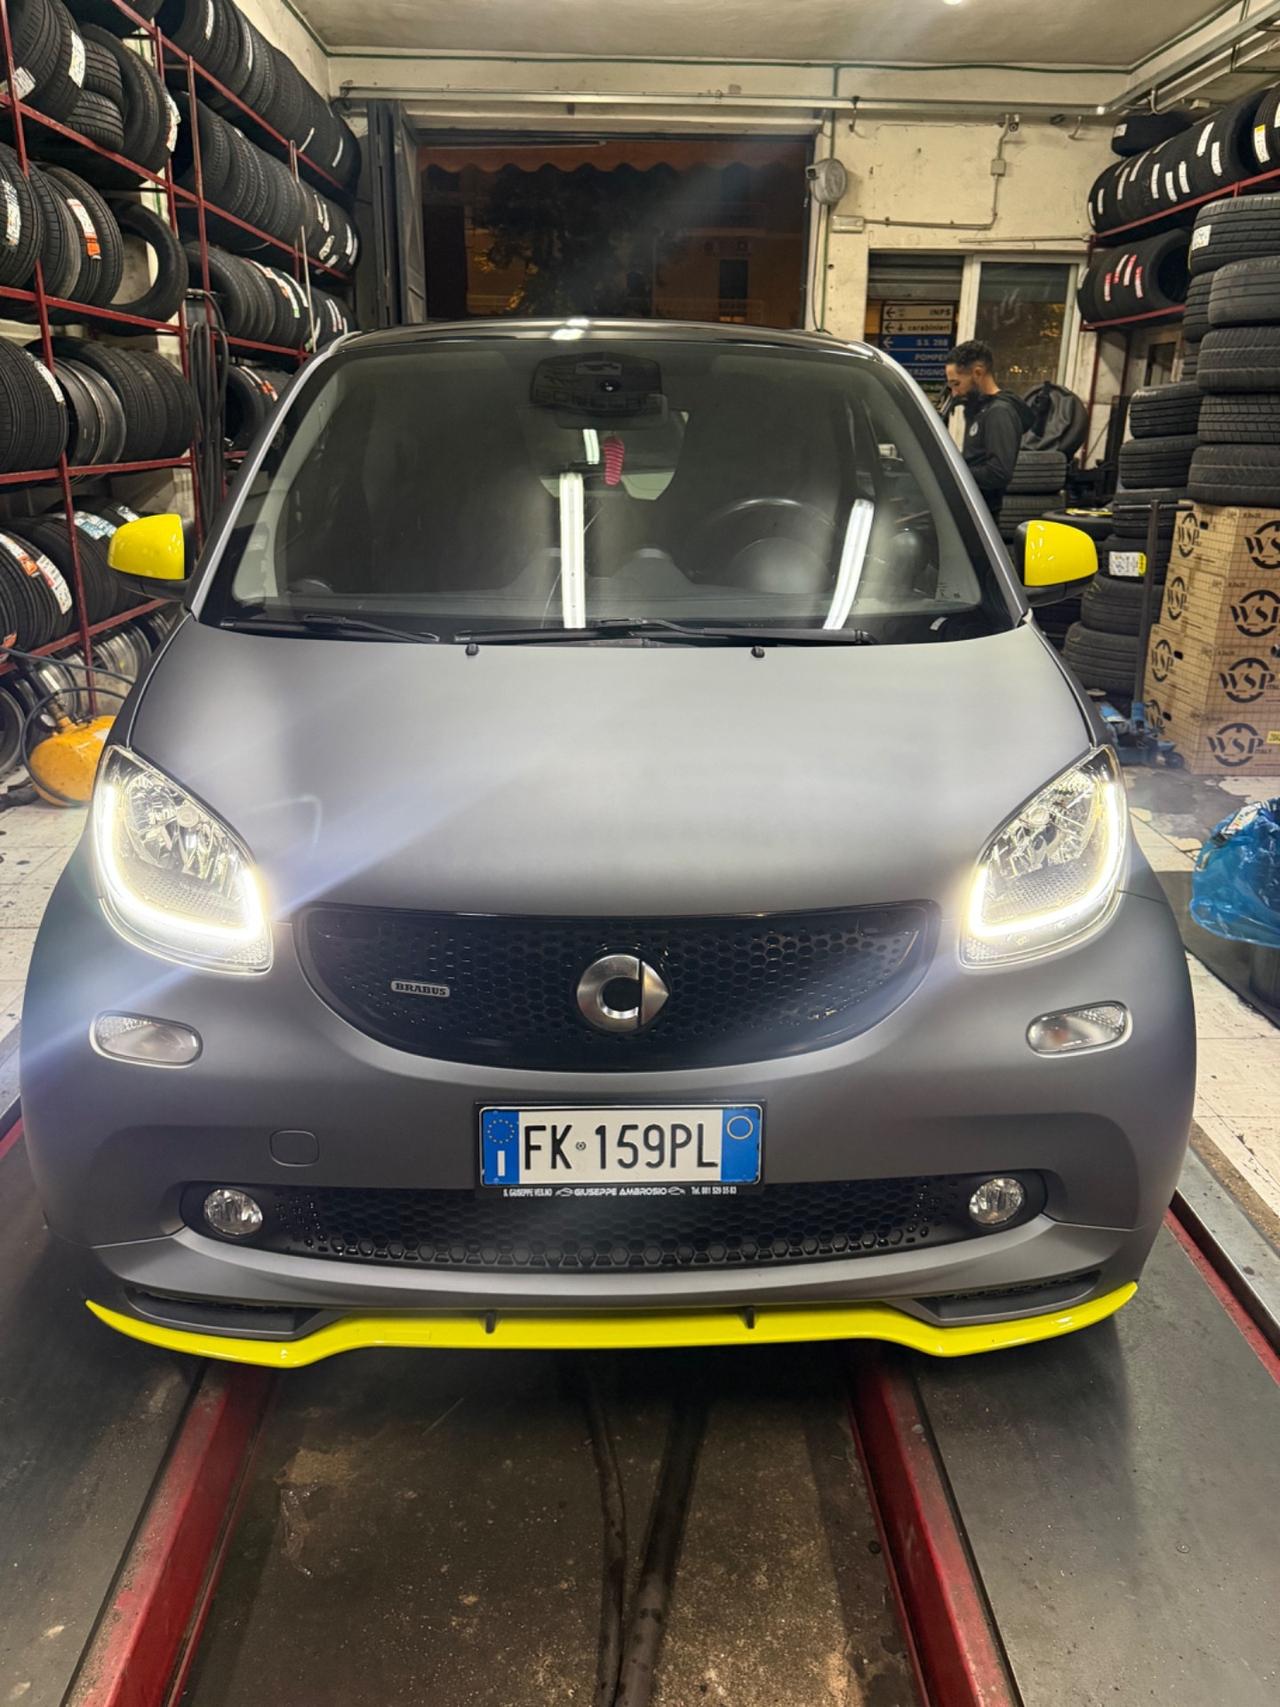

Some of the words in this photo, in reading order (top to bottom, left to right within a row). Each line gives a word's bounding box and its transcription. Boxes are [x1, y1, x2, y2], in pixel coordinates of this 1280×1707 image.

[1218, 672, 1275, 690] WSP
[1206, 735, 1264, 754] WSP
[395, 983, 447, 996] BRABUS
[524, 1124, 573, 1171] FK
[594, 1122, 719, 1170] 159PL
[574, 1187, 618, 1197] GIUSEPPE
[619, 1186, 668, 1196] AMBROSIO
